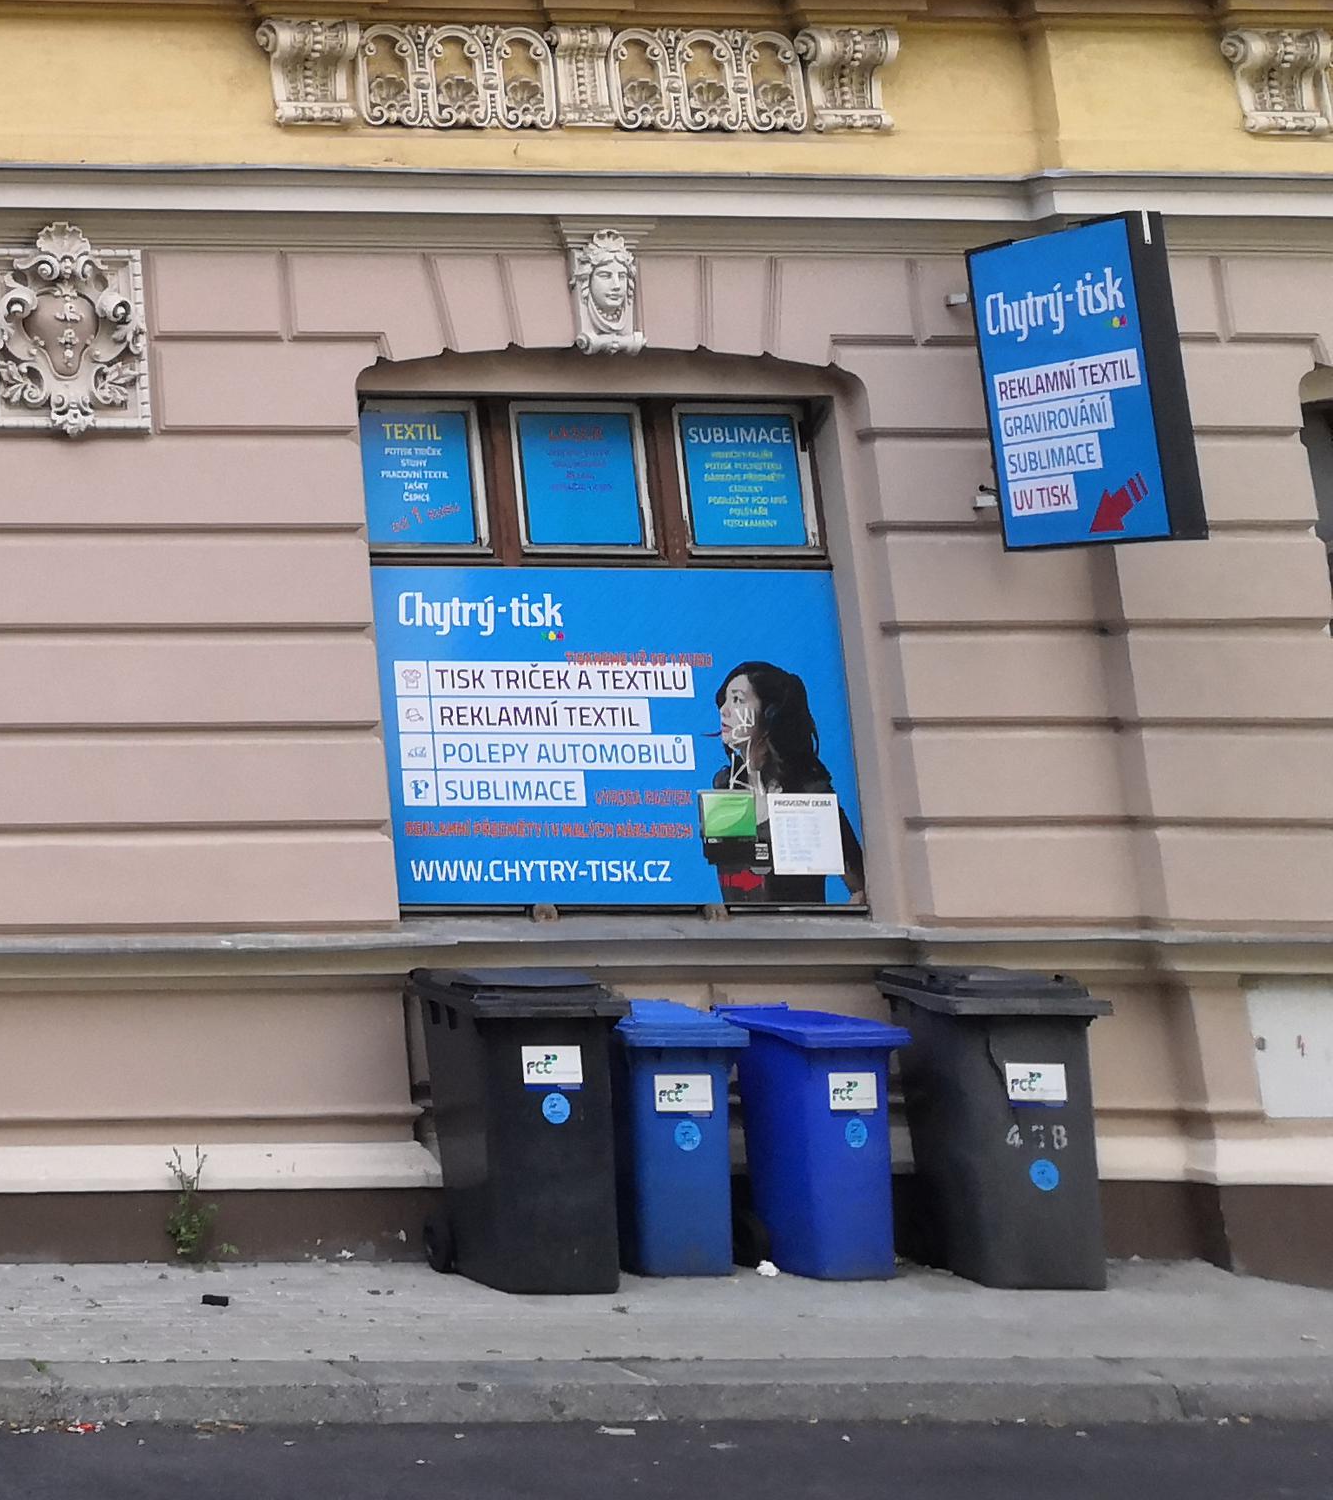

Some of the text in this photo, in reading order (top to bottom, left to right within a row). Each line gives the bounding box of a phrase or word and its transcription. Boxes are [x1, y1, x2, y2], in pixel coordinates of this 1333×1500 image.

[985, 267, 1125, 342] Chytrý-tisk
[998, 357, 1135, 401] REKLAMNÍ TEXTIL
[1003, 396, 1108, 437] GRAVIROVÁNÍ
[381, 423, 442, 440] TEXTIL
[688, 427, 792, 444] SUBLIMACE
[1008, 442, 1096, 474] SUBLIMACE
[1014, 484, 1071, 510] UV TISK
[398, 592, 564, 636] Chytrý-tisk
[435, 663, 687, 691] TISK TRIČEK A TEXTILU
[439, 701, 640, 727] REKLAMNÍ TEXTIL
[443, 736, 687, 764] POLEPY AUTOMOBILŮ
[445, 780, 577, 801] SUBLIMACE
[410, 859, 673, 883] WWW.CHYTRY-TISK.CZ
[526, 1061, 553, 1075] FCC
[658, 1089, 683, 1103] FCC
[832, 1088, 853, 1101] FCC
[1011, 1079, 1037, 1093] FCC
